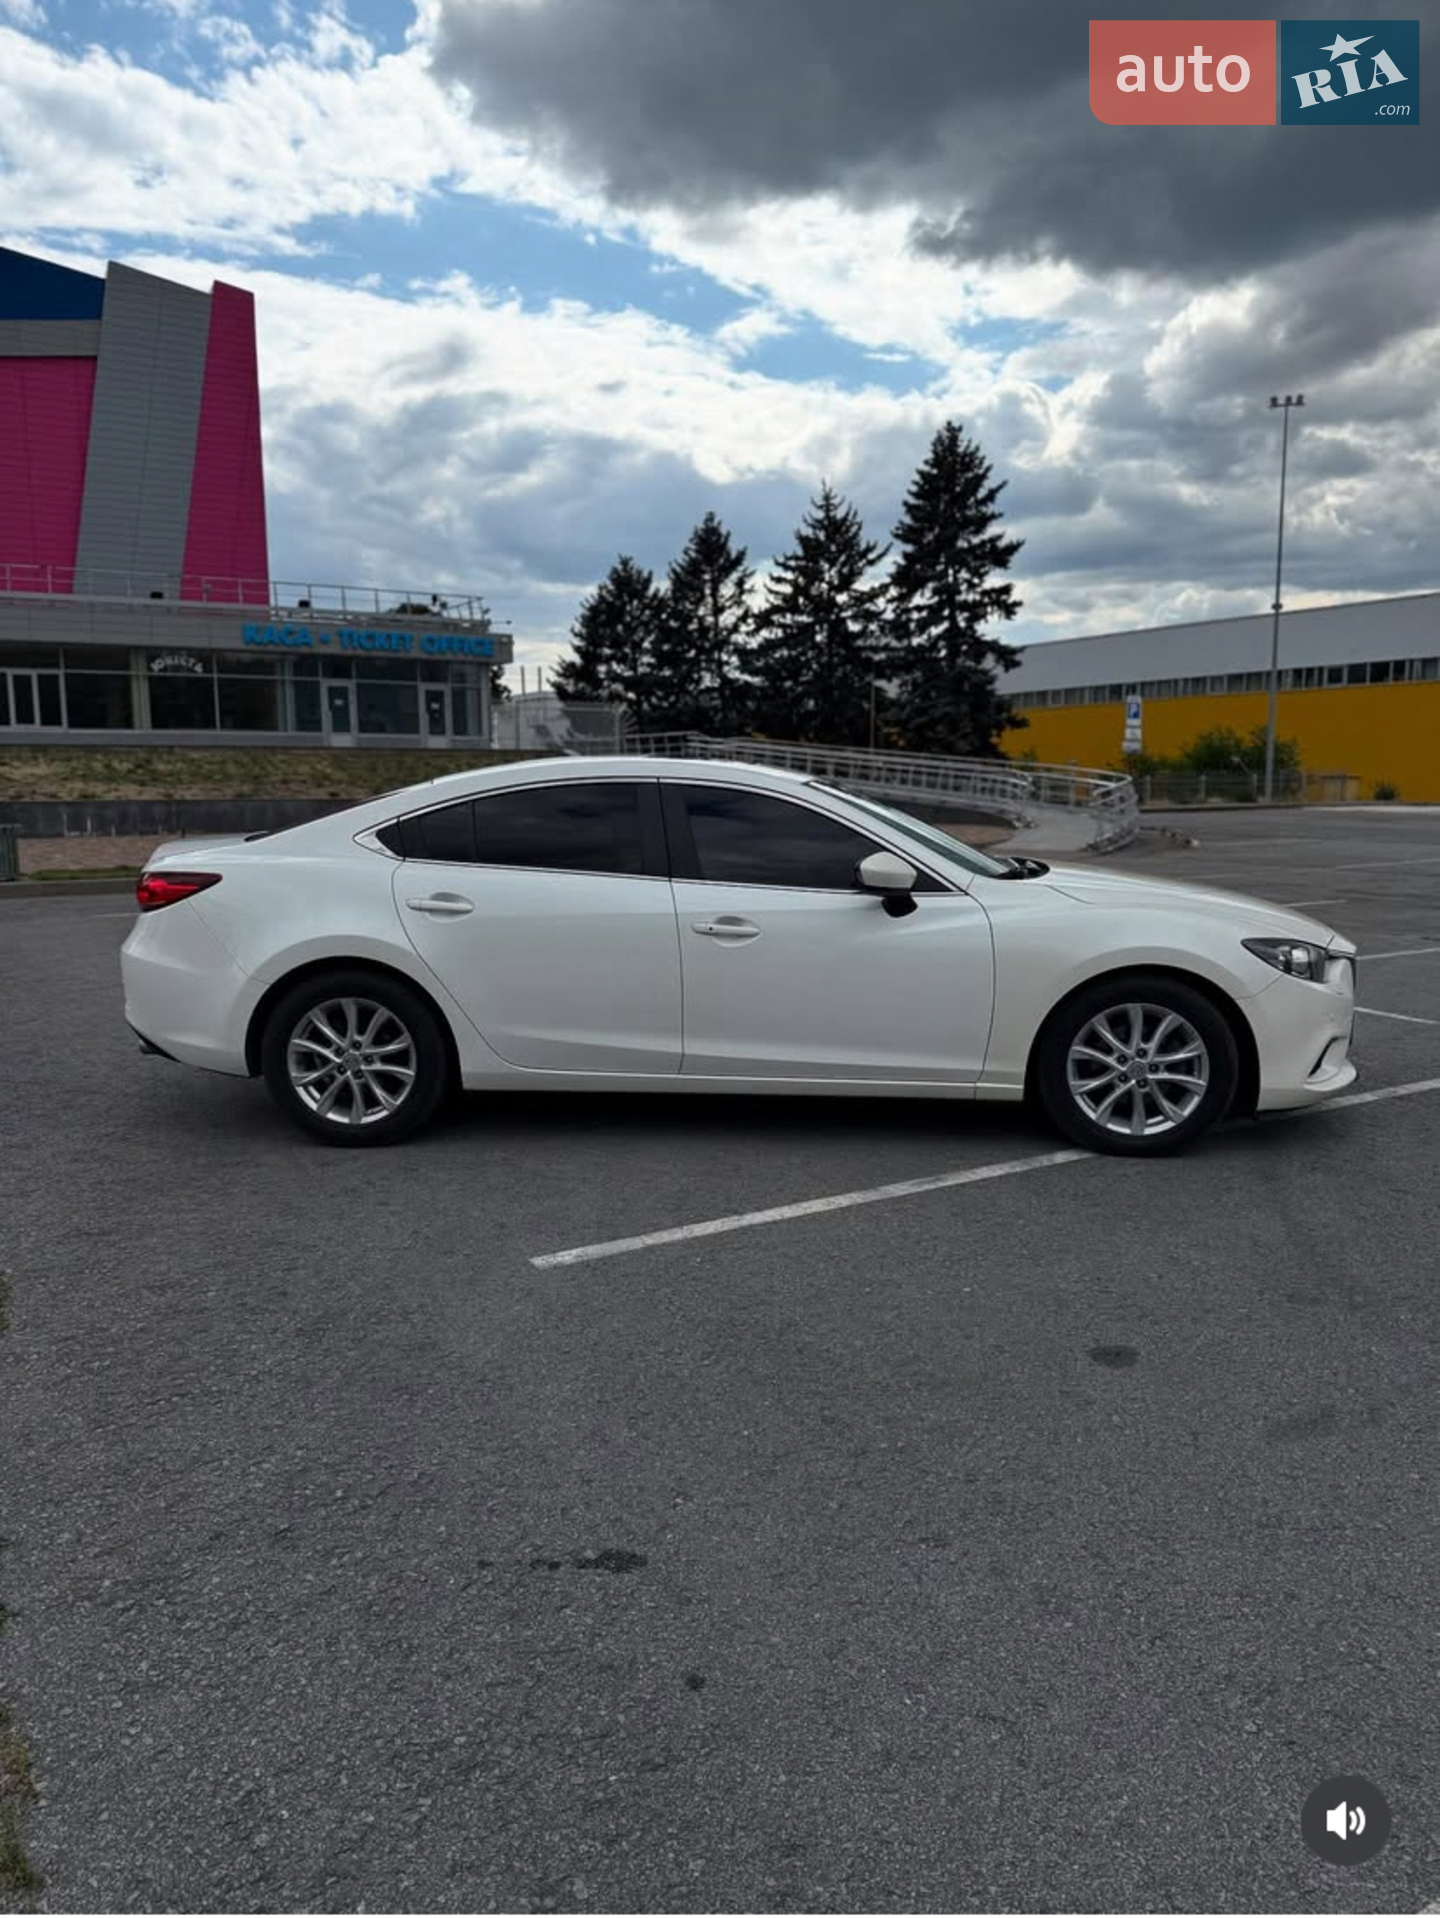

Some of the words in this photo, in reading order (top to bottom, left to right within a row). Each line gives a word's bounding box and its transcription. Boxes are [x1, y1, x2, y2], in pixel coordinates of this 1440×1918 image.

[242, 623, 313, 647] КАСА
[338, 628, 413, 652] TICKET
[422, 633, 495, 657] OFFICE
